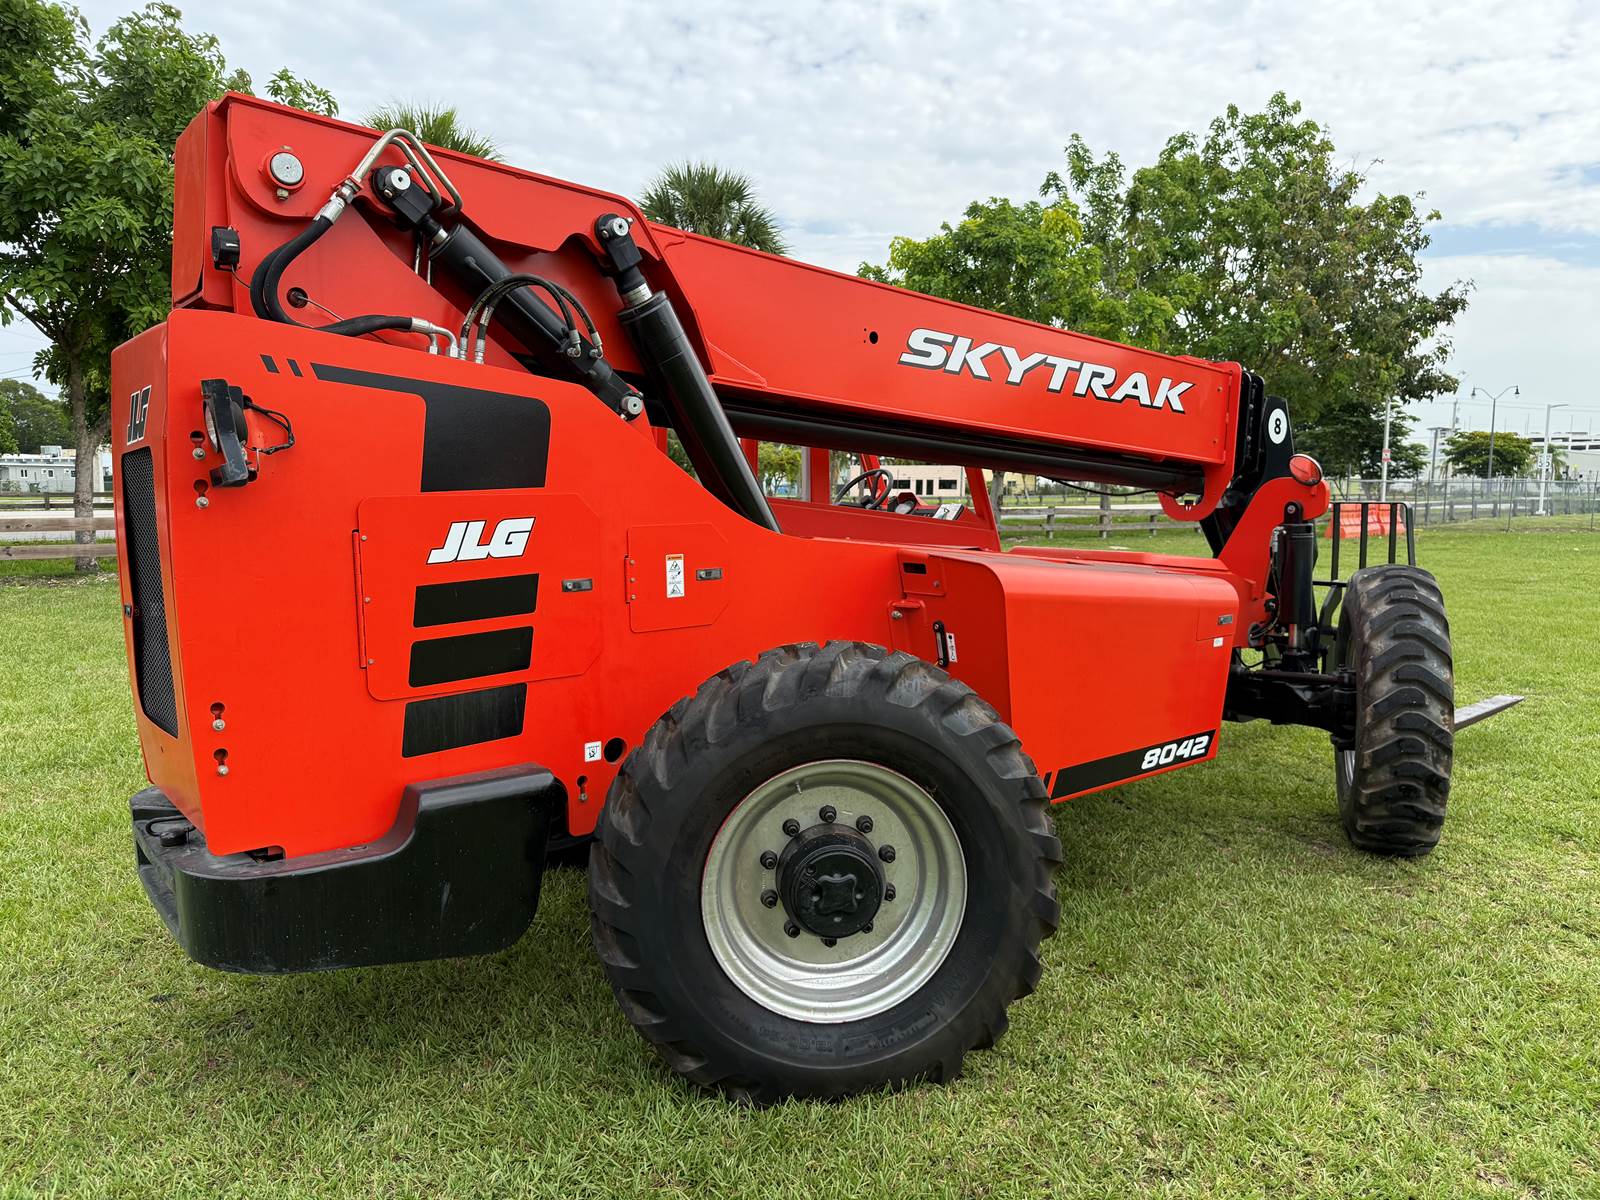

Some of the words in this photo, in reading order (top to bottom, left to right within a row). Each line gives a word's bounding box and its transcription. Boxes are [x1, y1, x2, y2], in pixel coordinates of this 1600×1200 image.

[898, 328, 1195, 414] SKYTRAK
[127, 385, 152, 445] JLG
[1274, 417, 1281, 435] 8
[426, 517, 536, 565] JLG
[1141, 735, 1209, 769] 8042
